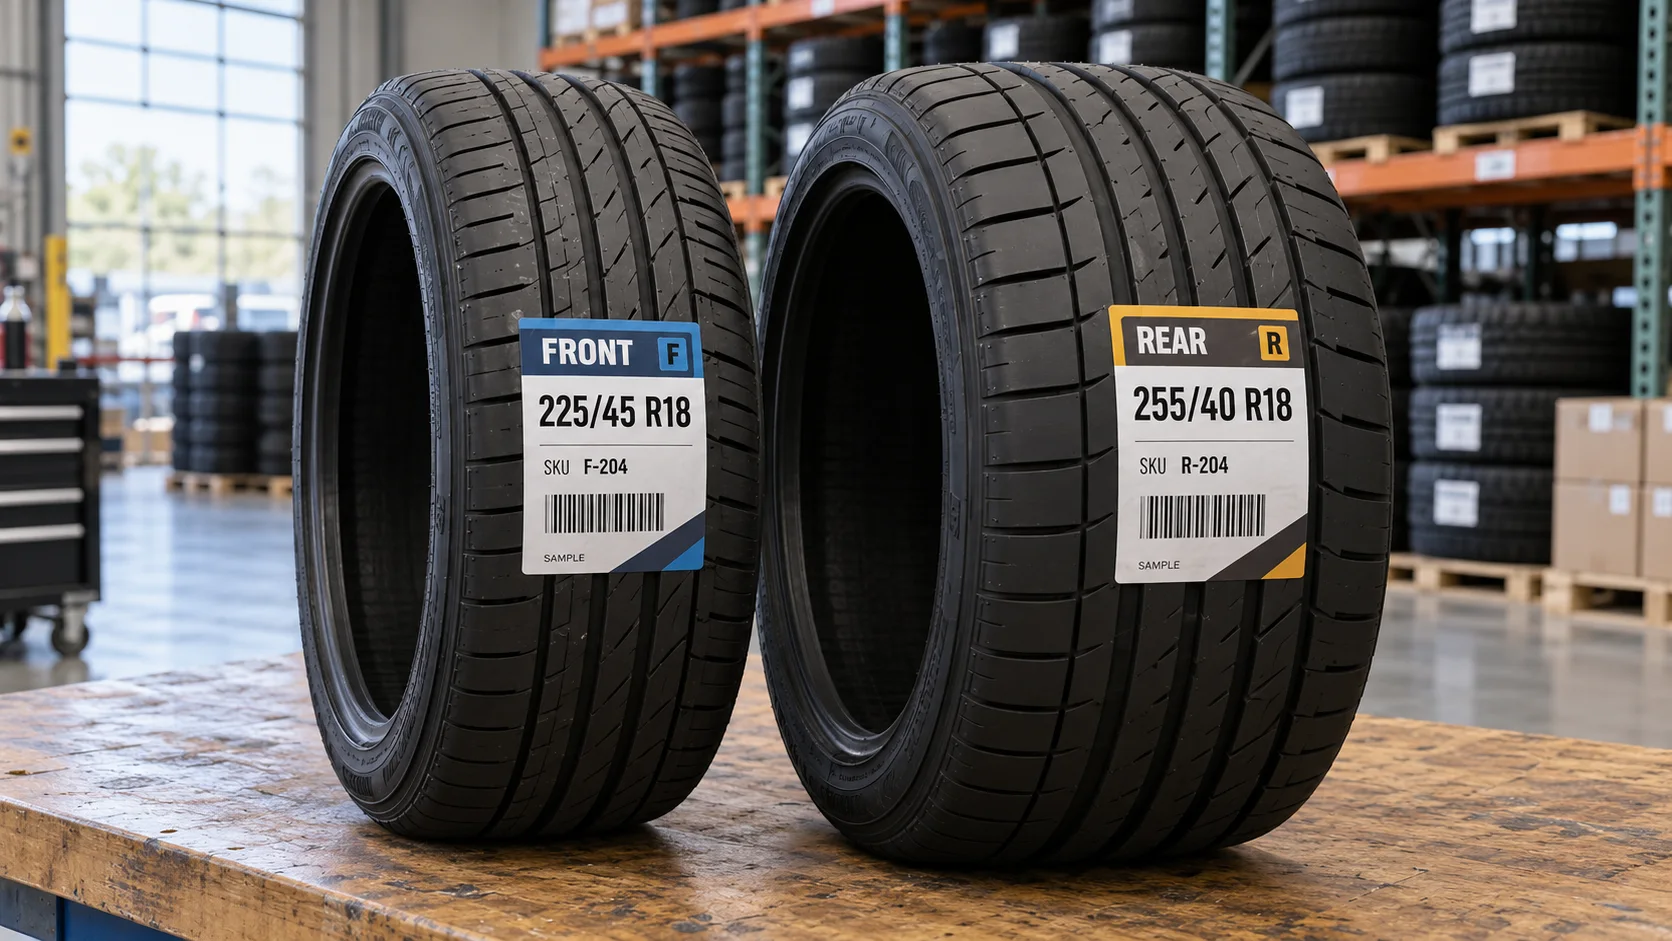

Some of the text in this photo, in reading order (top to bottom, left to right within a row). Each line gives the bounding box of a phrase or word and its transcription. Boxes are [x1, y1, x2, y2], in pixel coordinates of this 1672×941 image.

[541, 337, 633, 366] FRONT
[1136, 325, 1208, 355] REAR
[1266, 331, 1283, 355] R
[666, 342, 680, 365] F
[539, 394, 691, 429] 225/45 R18
[1133, 385, 1293, 423] 255/40 R18
[543, 458, 628, 476] SKU F-204
[1139, 456, 1229, 475] SKU R-204
[543, 553, 585, 563] SAMPLE
[1138, 560, 1180, 570] SAMPLE
